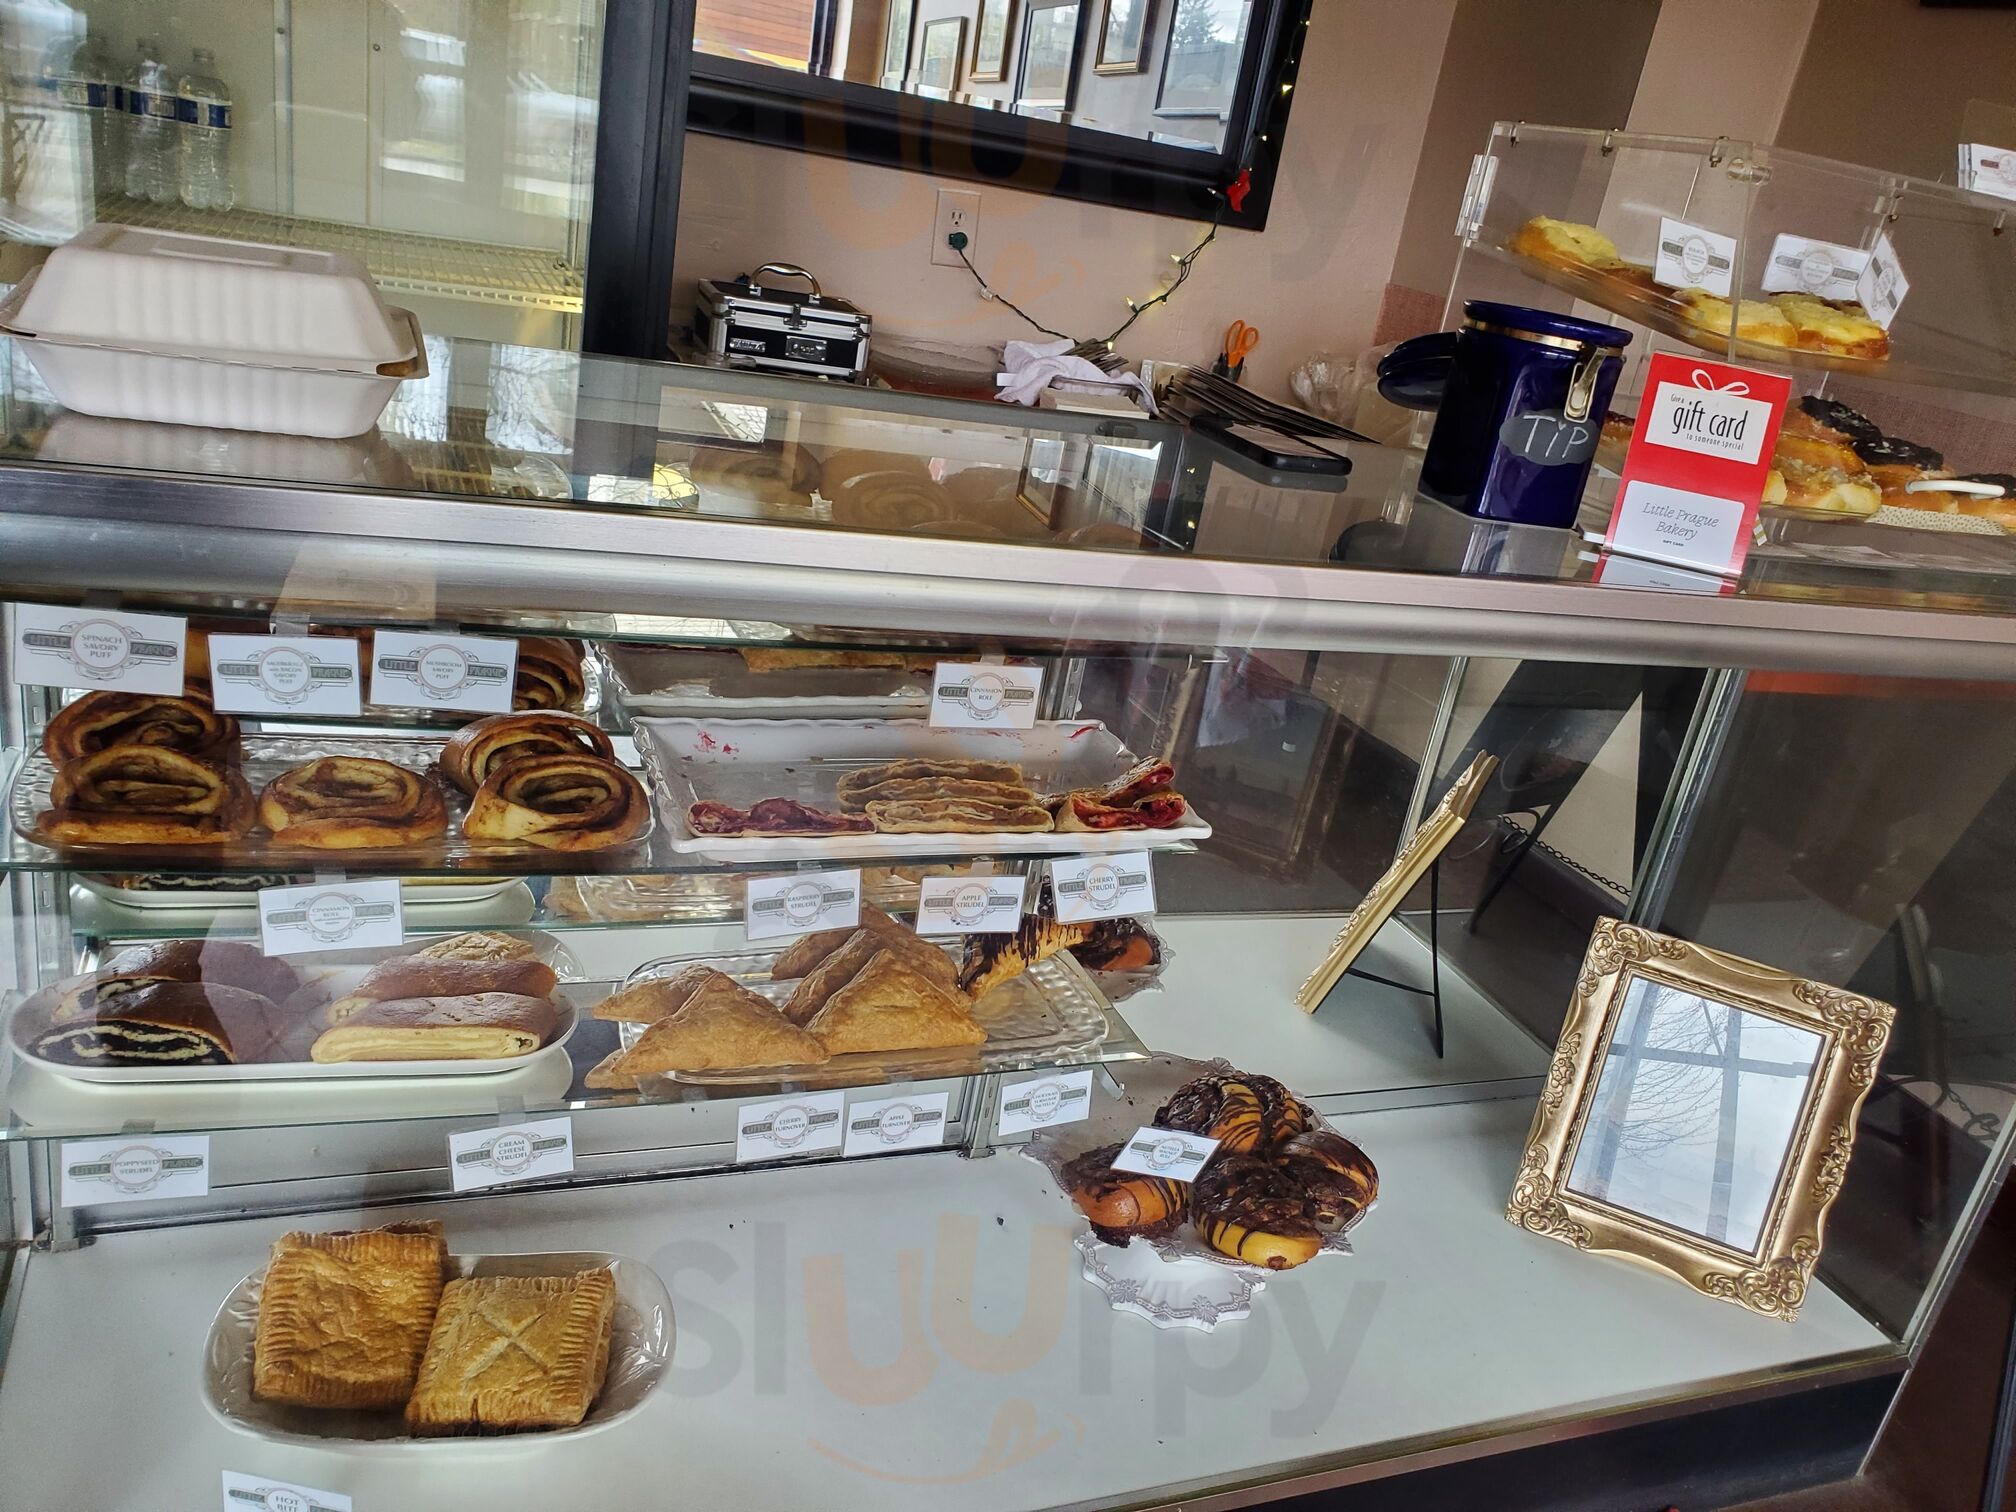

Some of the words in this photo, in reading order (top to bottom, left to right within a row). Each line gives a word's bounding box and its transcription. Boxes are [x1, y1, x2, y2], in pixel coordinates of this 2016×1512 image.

[1672, 400, 1706, 434] gift
[1709, 410, 1749, 440] card
[1694, 435, 1721, 446] someone
[1722, 441, 1744, 450] special
[1642, 502, 1675, 518] Little
[1675, 509, 1720, 528] Prague
[1656, 521, 1698, 541] Bakery
[81, 633, 122, 644] SPINACH
[83, 642, 120, 651] SAVORY
[90, 650, 112, 658] PUFF
[384, 659, 418, 672] LITTLE
[943, 687, 967, 697] LITTLE
[1088, 875, 1115, 885] CHERRY
[1088, 883, 1116, 892] STRUDEL
[787, 893, 820, 902] RASPBERRY
[312, 905, 350, 913] CINNAMON
[790, 900, 817, 909] STRUDEL
[779, 1116, 801, 1125] CHERRY
[882, 1120, 911, 1129] TURNOVER
[746, 1122, 771, 1134] LITTLE
[775, 1123, 806, 1132] TURNOVER
[498, 1140, 525, 1148] CREAM
[498, 1146, 526, 1155] CHEESE
[496, 1152, 528, 1161] STRUDEL
[275, 1495, 299, 1506] HOT
